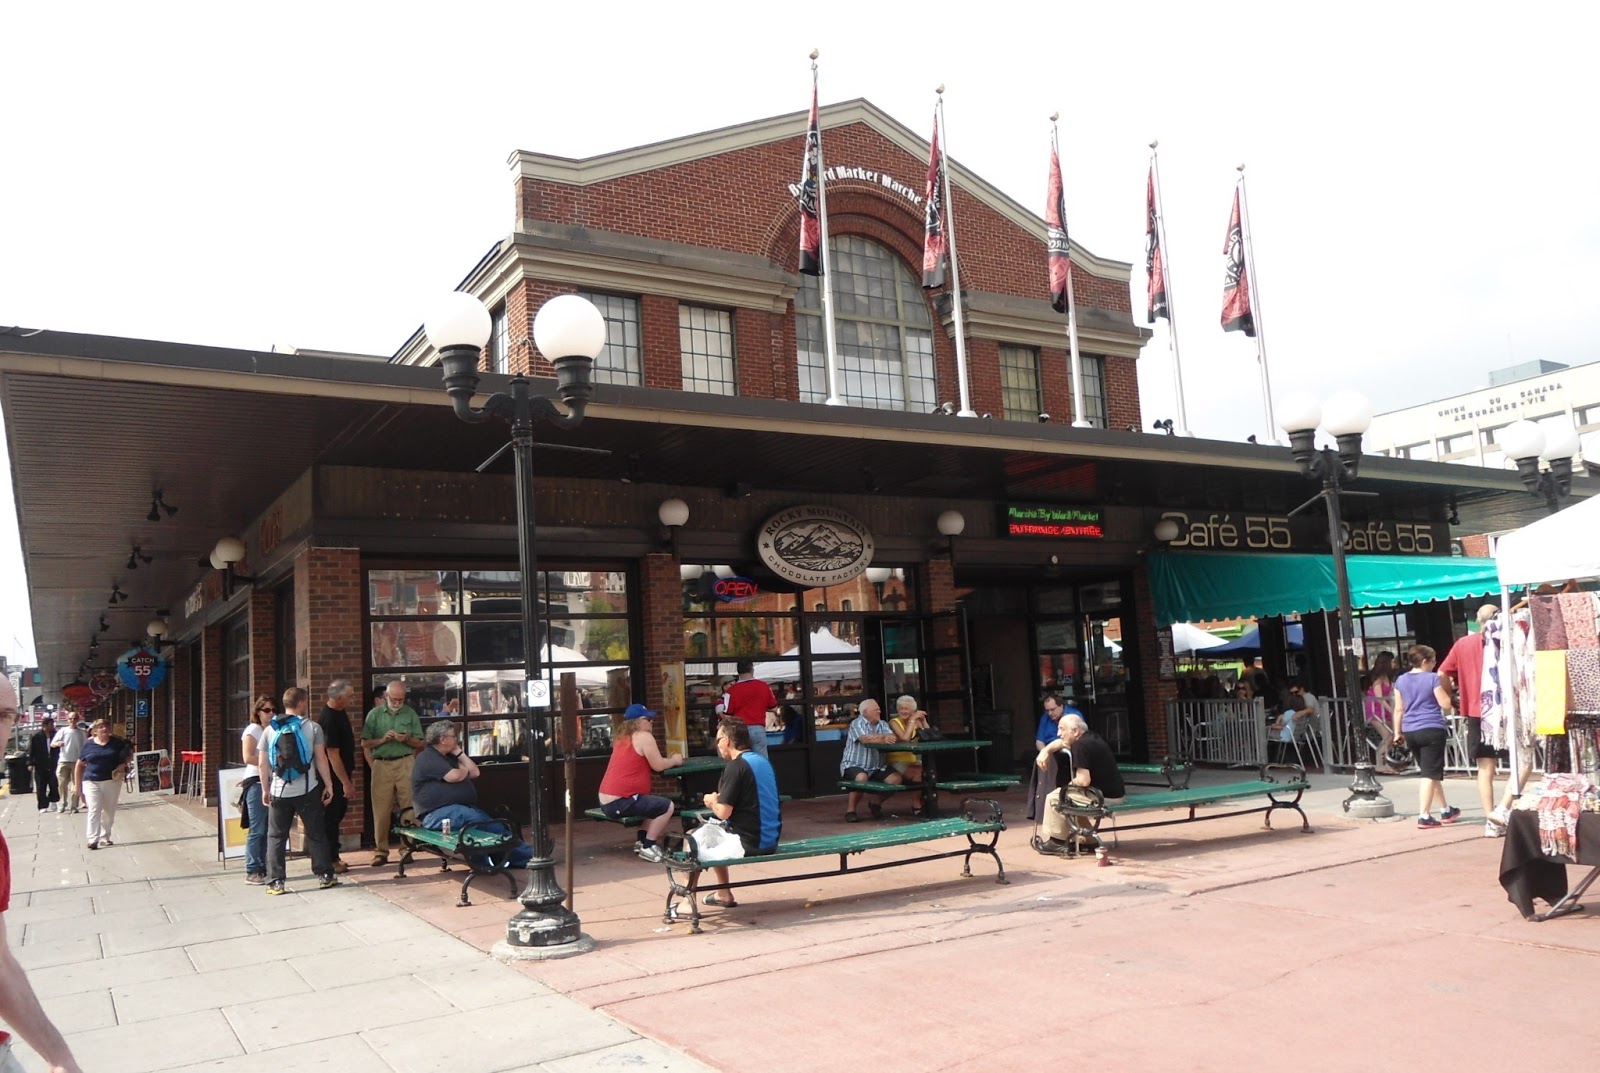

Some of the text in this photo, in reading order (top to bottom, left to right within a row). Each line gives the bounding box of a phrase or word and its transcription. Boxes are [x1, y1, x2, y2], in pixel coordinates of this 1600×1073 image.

[835, 166, 878, 183] Market
[1438, 383, 1563, 417] UNION DU CANADA
[765, 507, 868, 537] ROCKY MOUNTAIN
[1161, 512, 1292, 548] Café 55
[1395, 523, 1434, 553] 55
[768, 555, 869, 582] CHOCOLATE FACTORY
[714, 580, 758, 597] OPEN
[134, 665, 151, 676] 55
